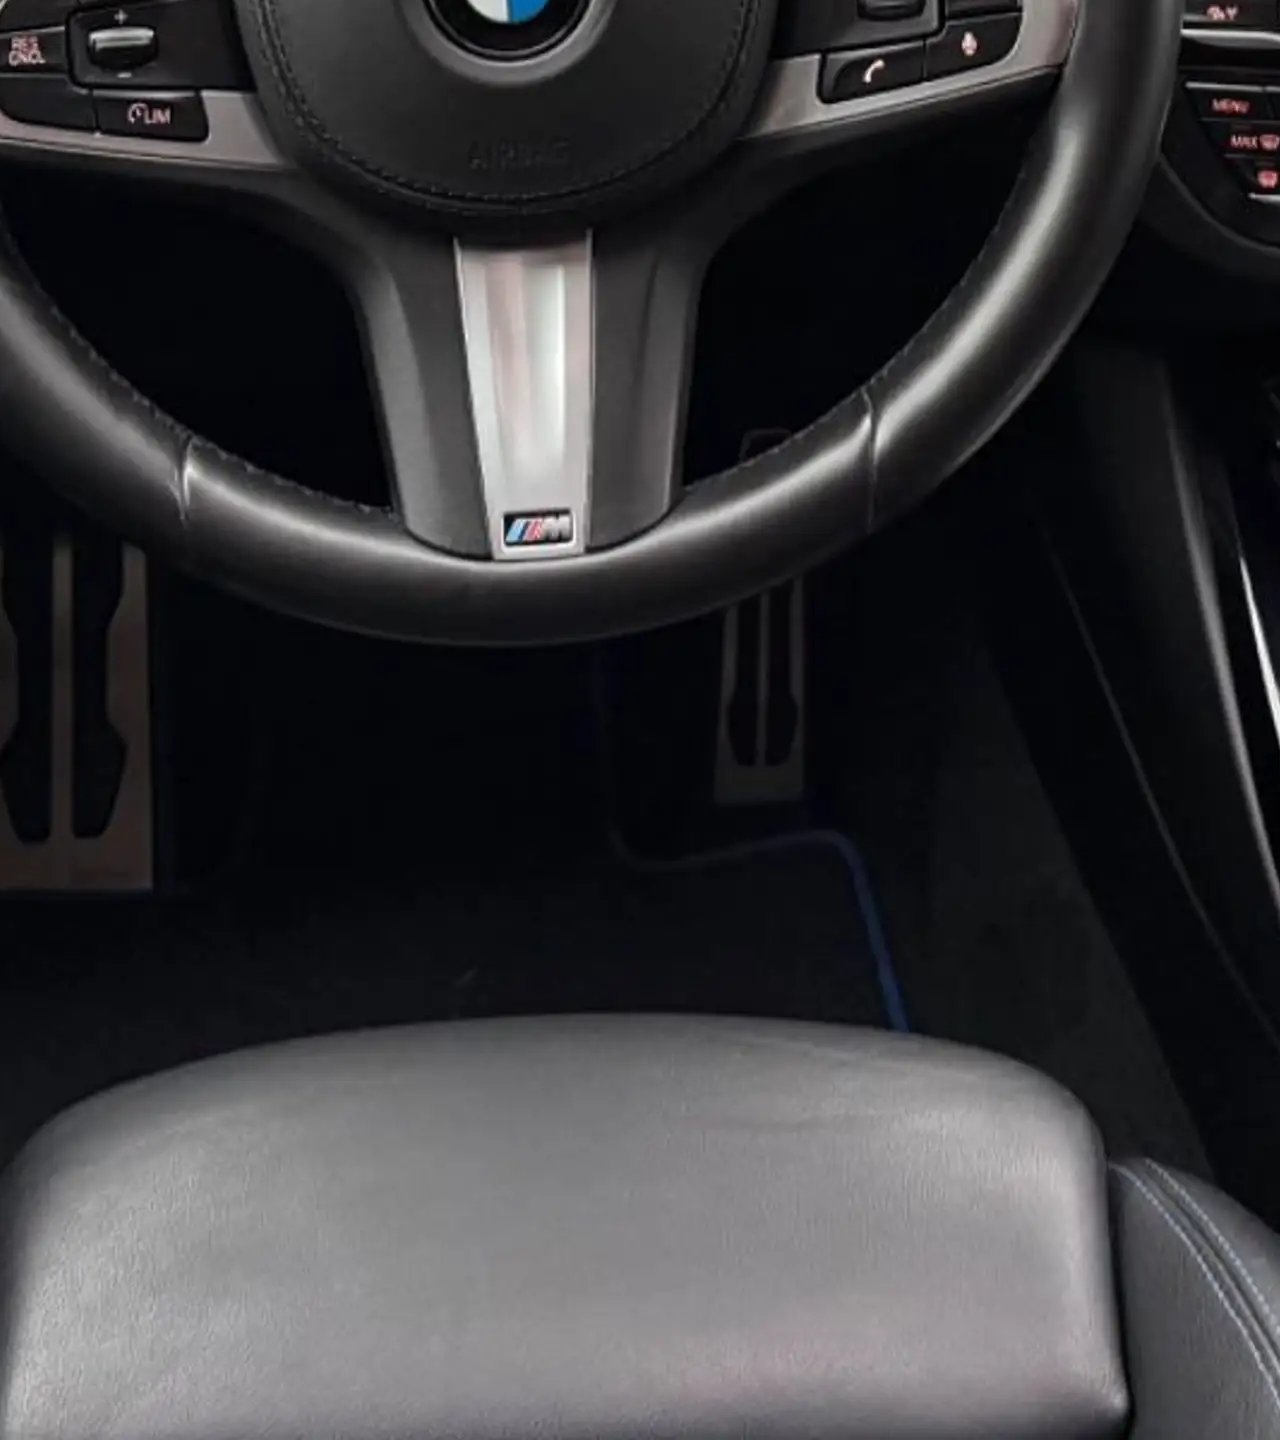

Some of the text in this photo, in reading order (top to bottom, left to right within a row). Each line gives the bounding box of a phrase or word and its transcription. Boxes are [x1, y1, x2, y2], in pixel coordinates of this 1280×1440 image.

[11, 35, 38, 49] RES
[1211, 98, 1251, 114] MENU
[144, 108, 170, 125] LIM
[1229, 134, 1258, 148] MAX
